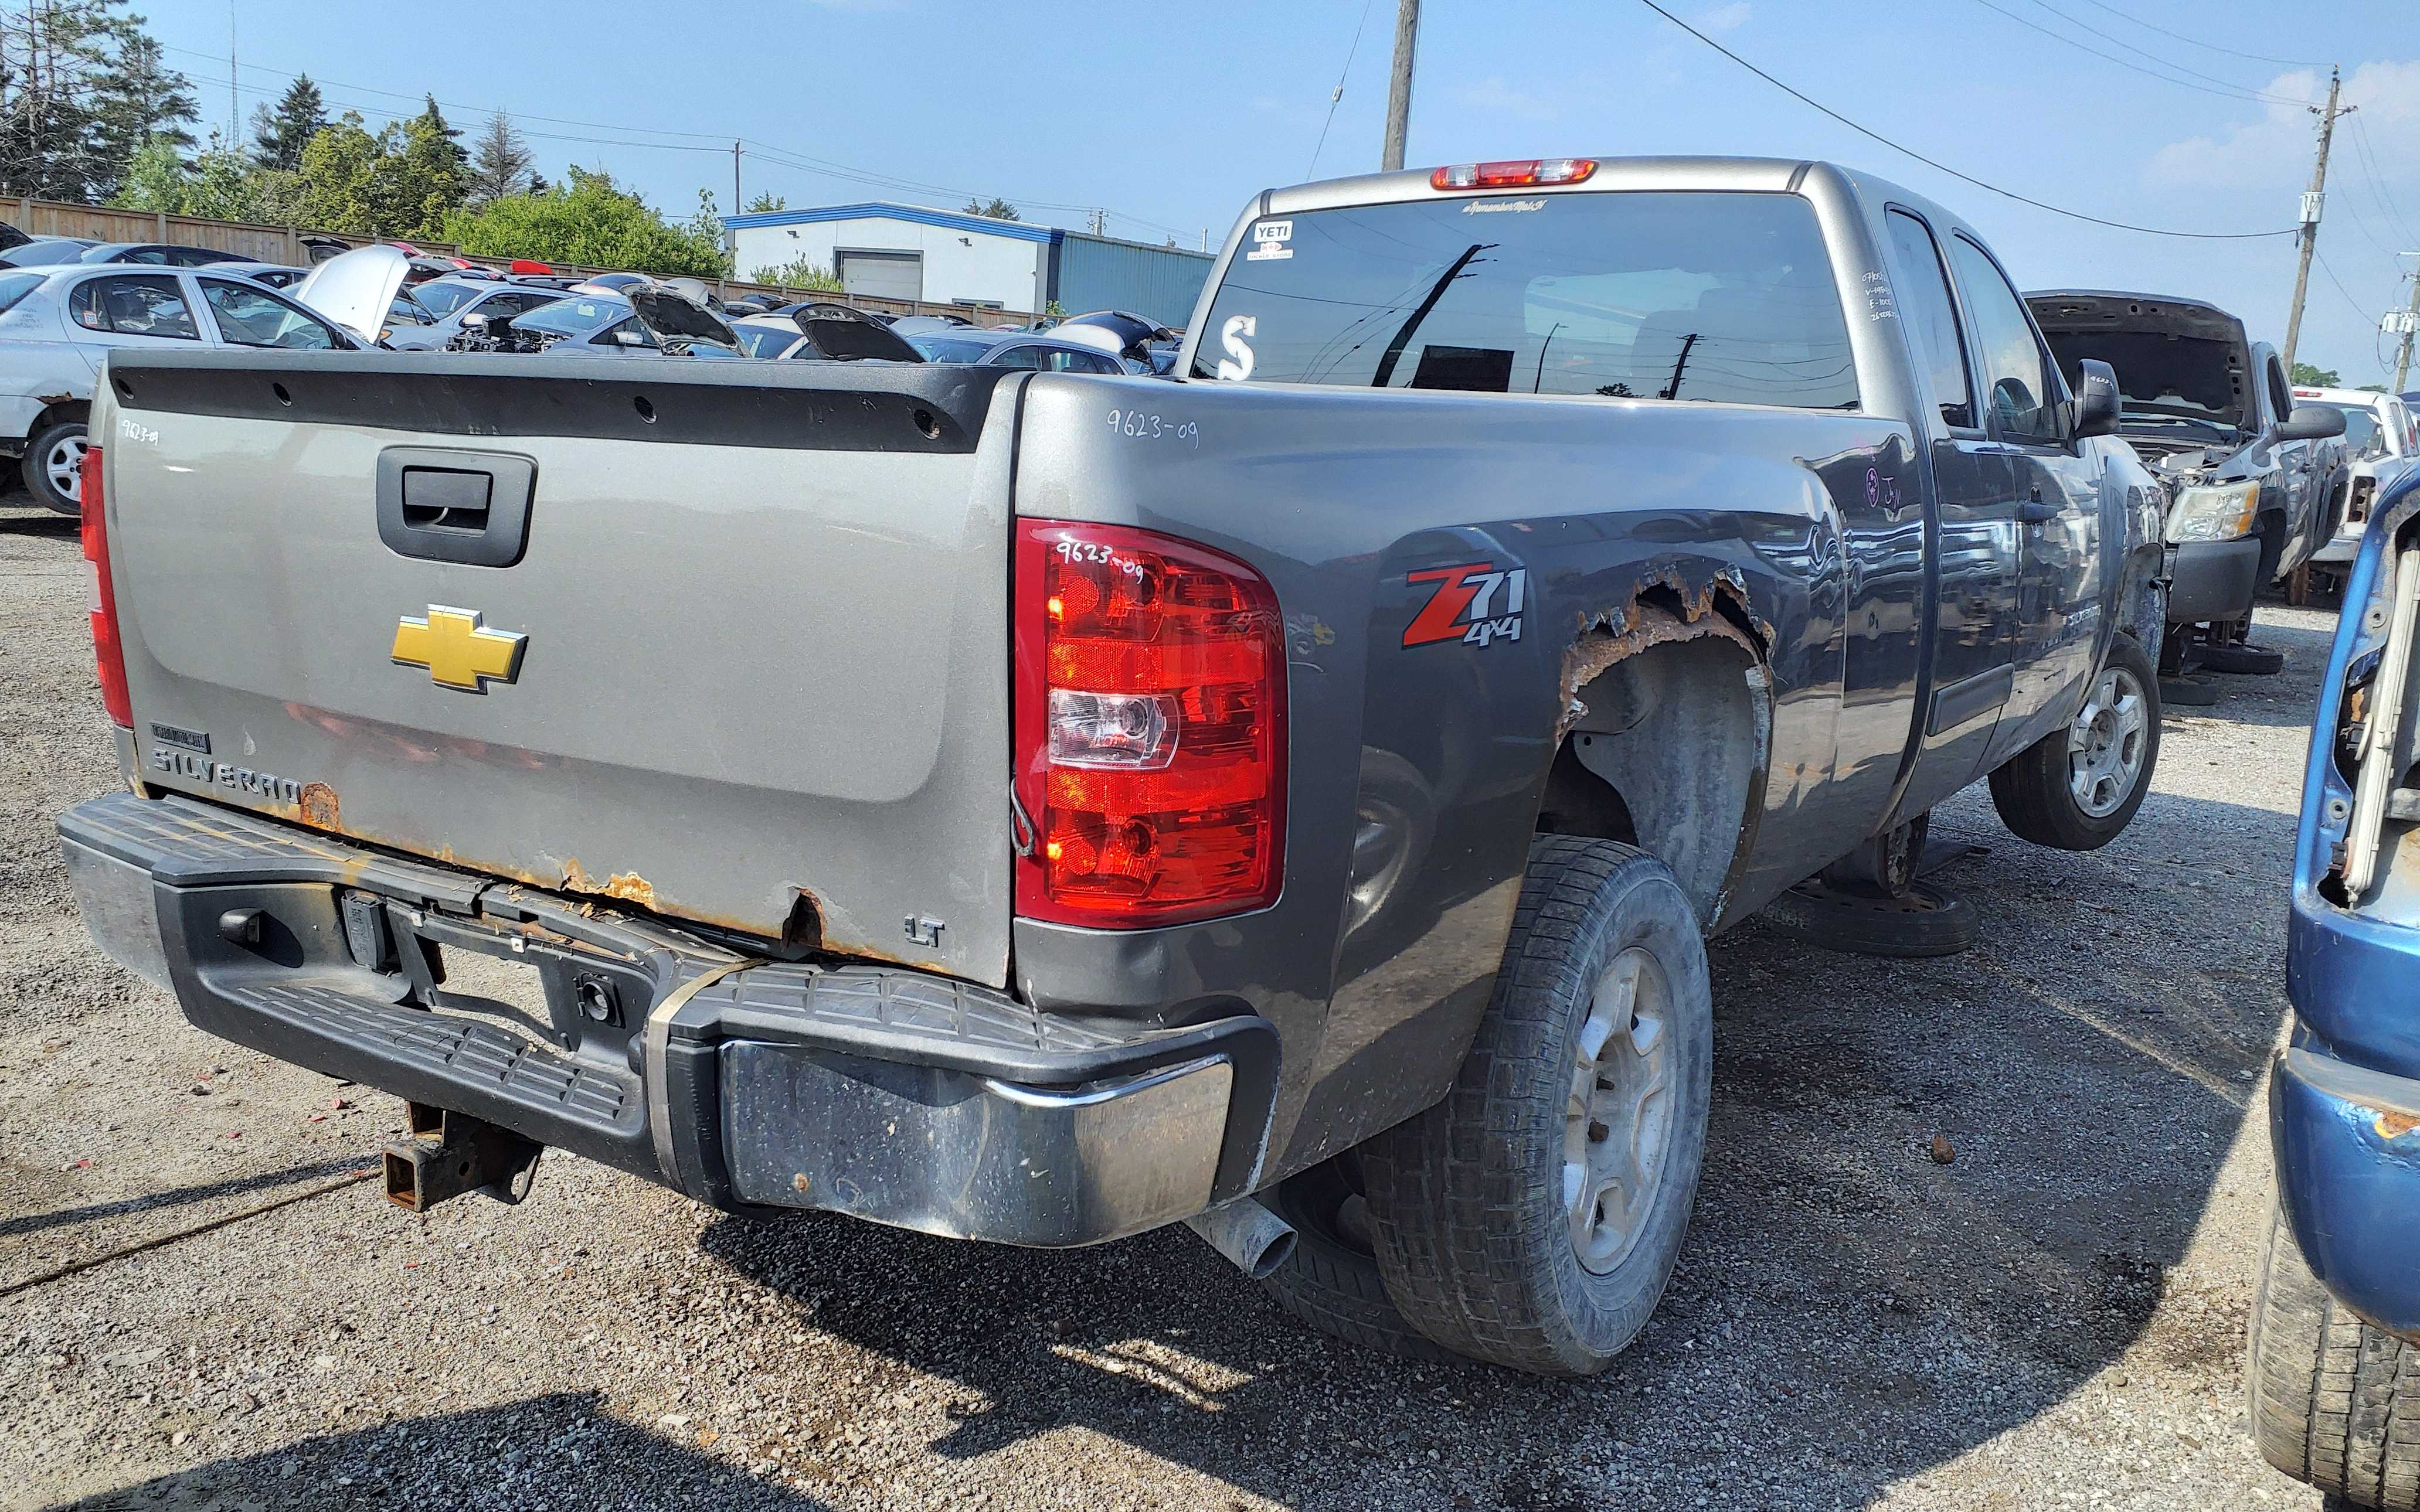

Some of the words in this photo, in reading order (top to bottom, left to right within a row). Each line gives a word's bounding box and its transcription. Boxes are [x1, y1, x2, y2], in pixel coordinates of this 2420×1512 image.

[1259, 226, 1288, 237] YETI
[1107, 410, 1199, 449] 9623-09
[1056, 542, 1143, 584] 9623-09
[1403, 561, 1527, 648] Z71
[905, 914, 945, 948] LT
